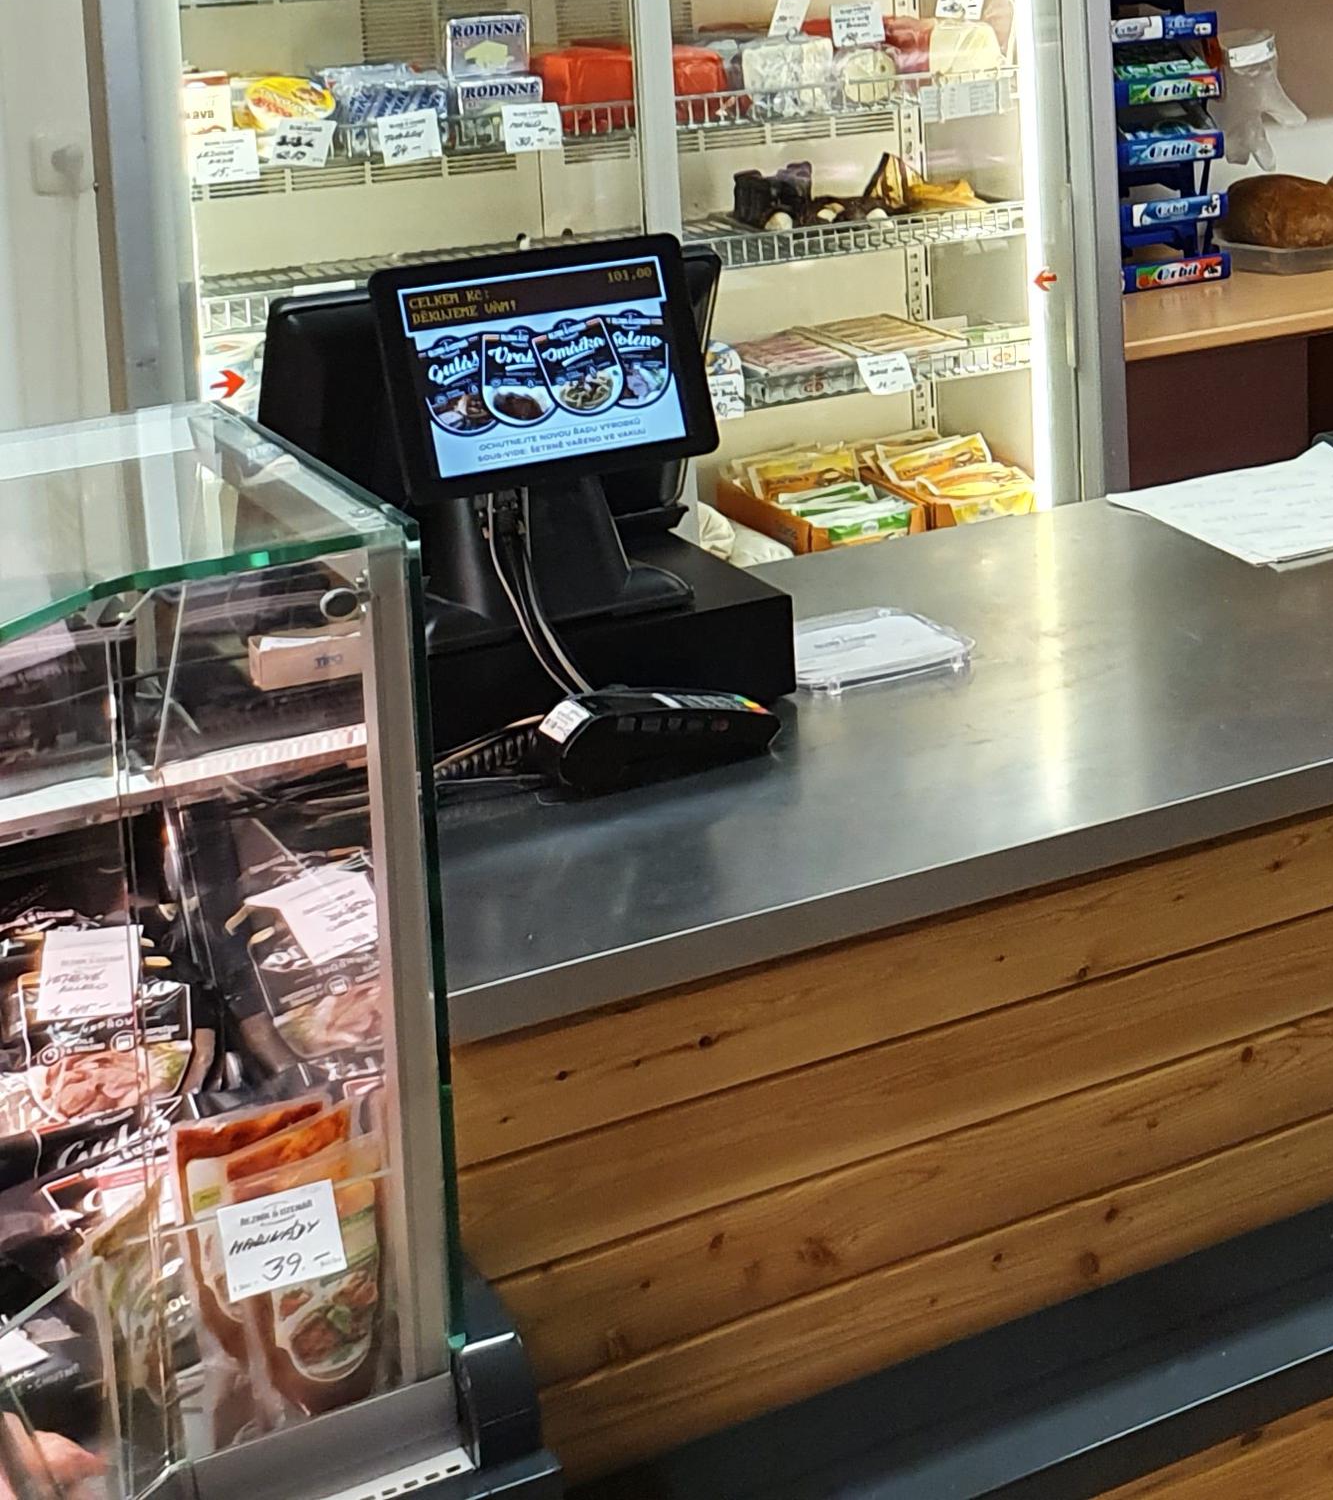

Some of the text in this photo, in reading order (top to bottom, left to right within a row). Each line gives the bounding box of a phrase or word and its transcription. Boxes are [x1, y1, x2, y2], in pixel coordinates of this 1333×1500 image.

[452, 18, 525, 37] RODINNÉ
[464, 81, 540, 99] RODINNÉ
[1150, 80, 1193, 98] Orbit
[1149, 143, 1192, 159] Orbit
[1156, 202, 1188, 216] Orbit
[607, 266, 653, 283] 101.00
[1157, 264, 1198, 280] Orbit
[408, 292, 460, 310] CELKEM
[541, 335, 606, 363] Omáčka
[479, 435, 537, 452] OCHUTNEJTE
[539, 430, 572, 440] NOVOU
[573, 425, 598, 435] ŘADU
[566, 435, 602, 447] VAŘENO
[604, 433, 616, 441] VE
[617, 428, 647, 439] VAKUU
